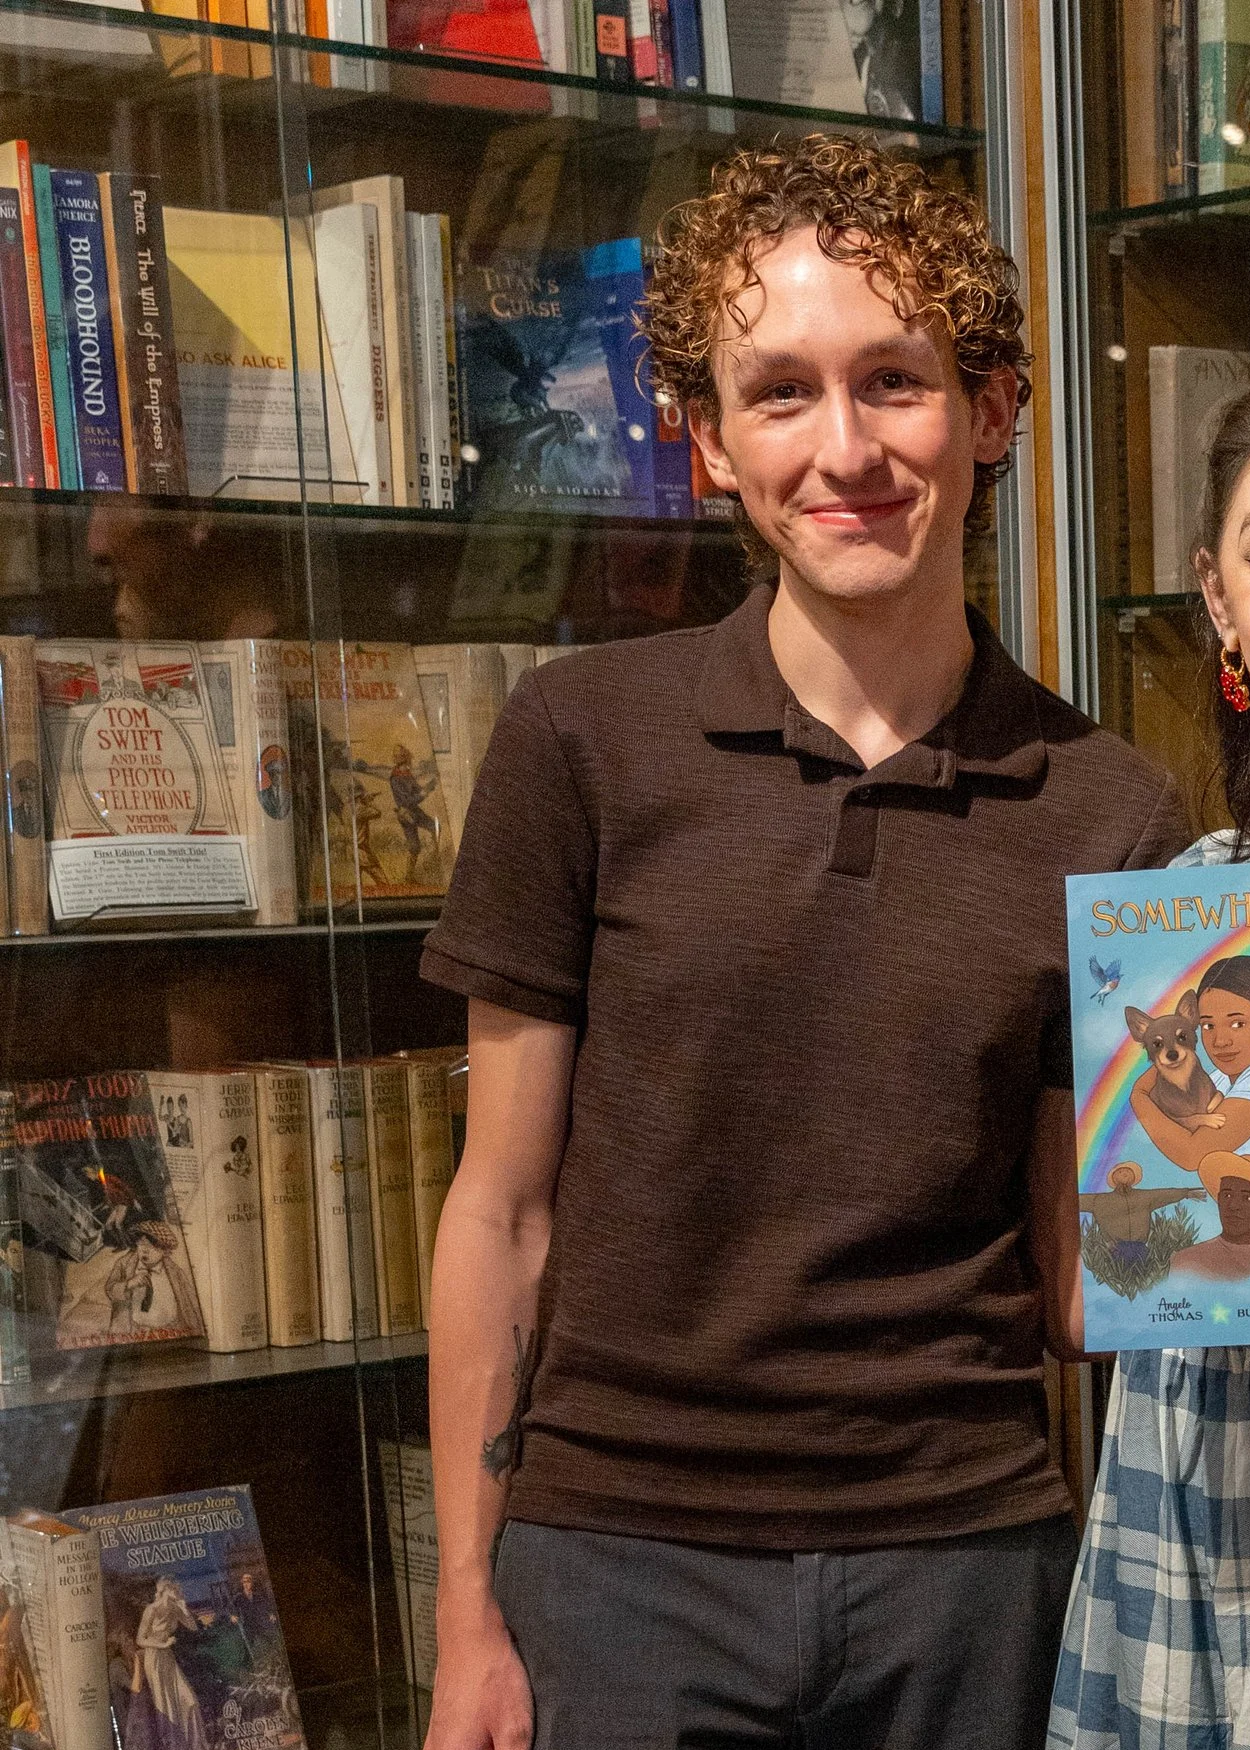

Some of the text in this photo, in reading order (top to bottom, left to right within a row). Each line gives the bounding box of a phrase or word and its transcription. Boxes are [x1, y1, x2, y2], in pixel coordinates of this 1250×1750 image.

[483, 266, 560, 295] TITAN'S
[490, 293, 563, 320] CURSE
[69, 235, 106, 416] BLOODHOUND
[137, 248, 163, 450] The Will of the Empress
[203, 353, 289, 370] ASK ALICE
[372, 345, 385, 423] DIGGERS
[103, 706, 150, 728] TOM
[96, 728, 163, 752] SWIFT
[111, 754, 162, 765] AND HIS
[107, 767, 176, 788] PHOTO
[98, 789, 196, 811] TELEPHONE
[125, 814, 170, 824] VICTOR
[126, 824, 178, 834] APPLETON
[1148, 1311, 1204, 1323] THOMAS
[163, 1495, 238, 1517] Mystery Stories
[120, 1509, 244, 1544] WHISPERING
[126, 1537, 207, 1570] STATUE
